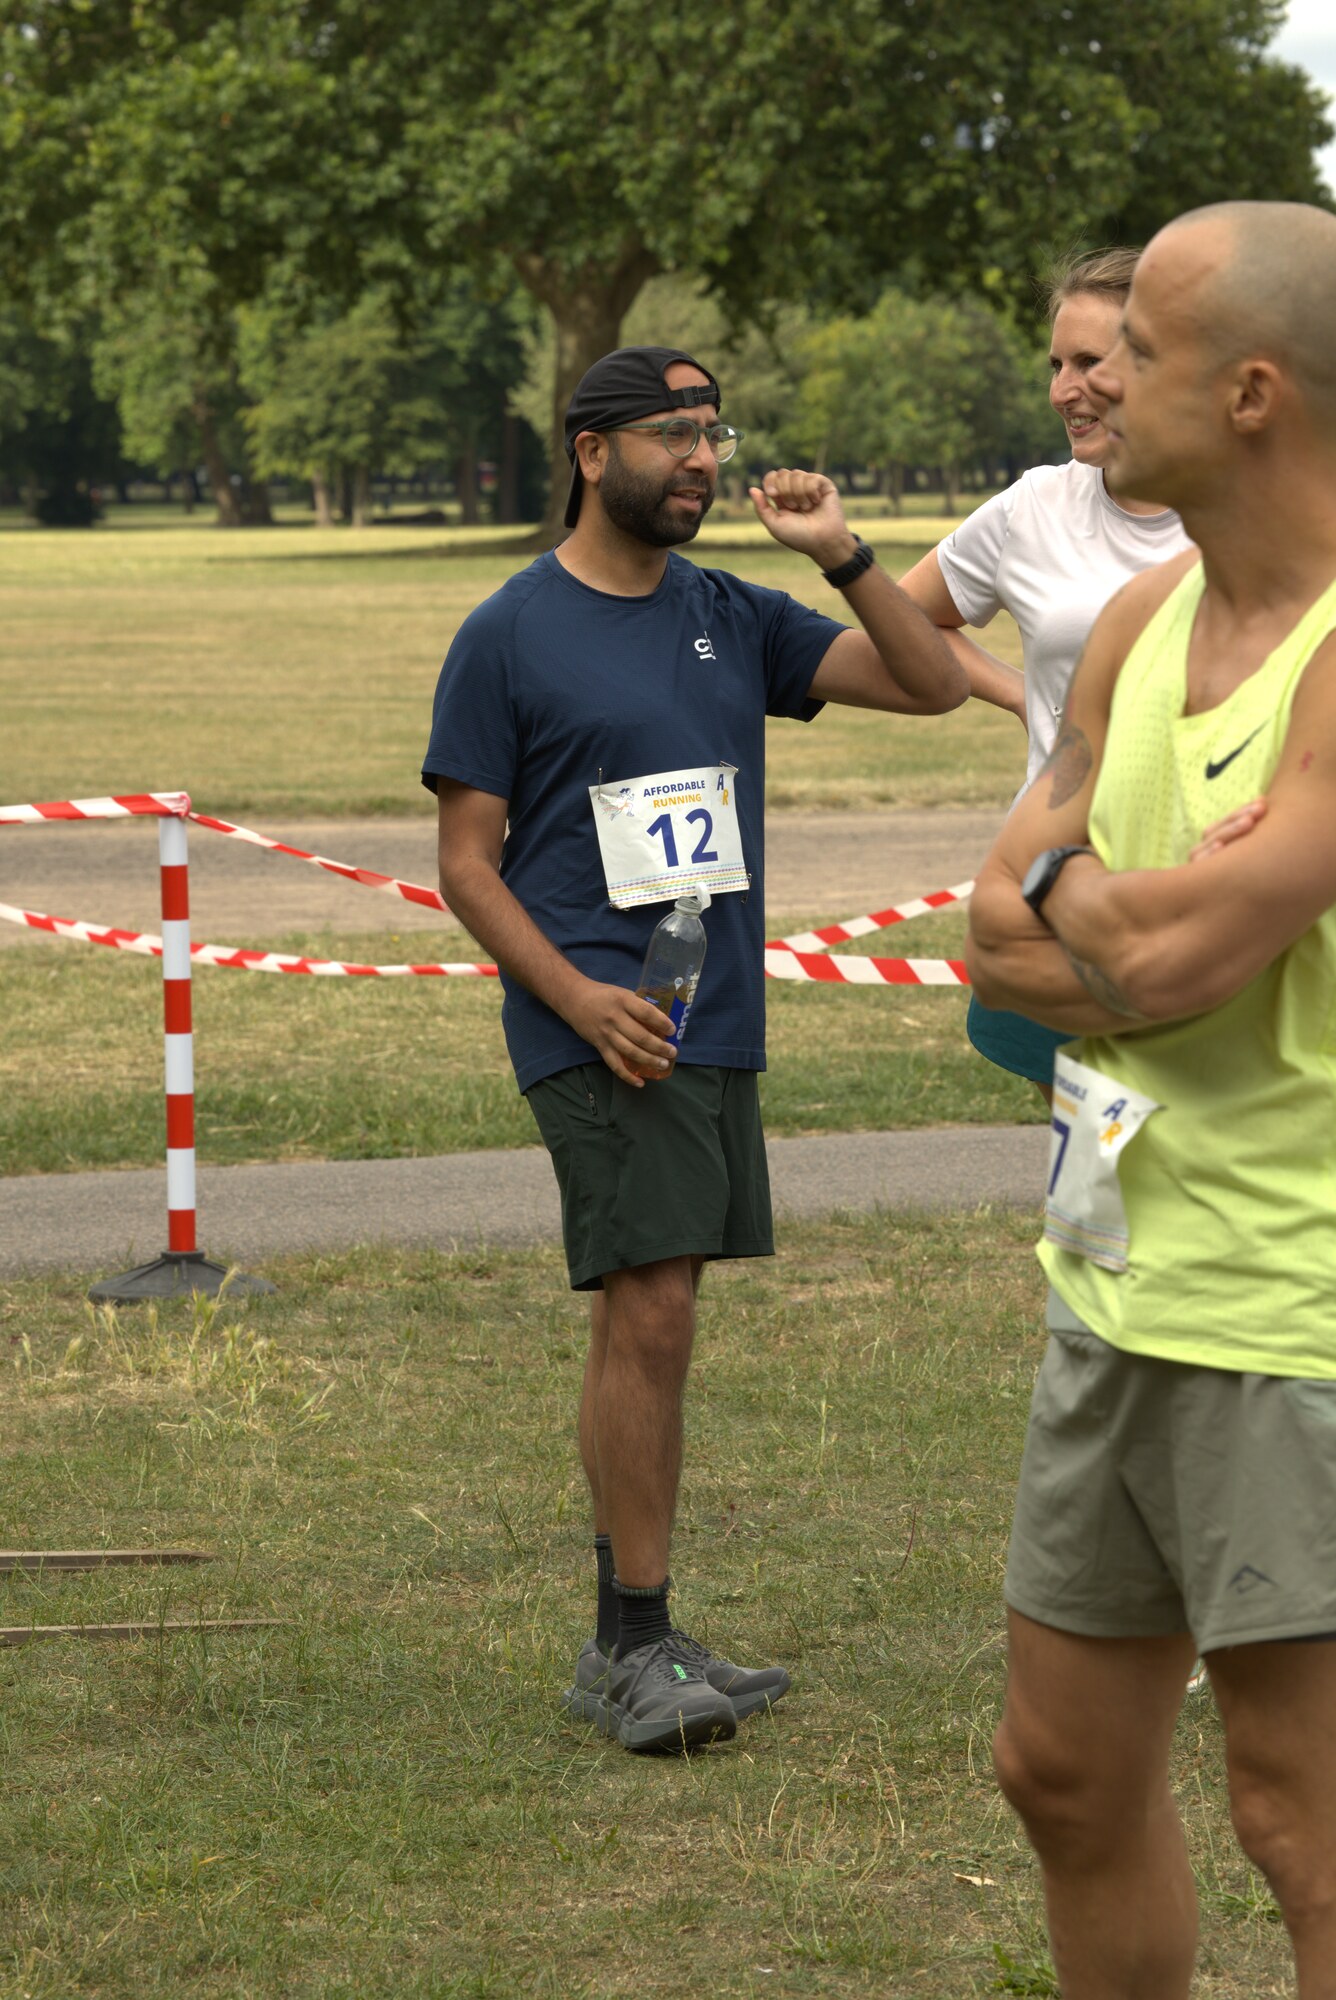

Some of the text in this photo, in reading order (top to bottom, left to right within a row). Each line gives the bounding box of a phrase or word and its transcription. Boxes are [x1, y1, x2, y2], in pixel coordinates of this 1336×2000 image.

[643, 780, 706, 797] AFFORDABLE
[653, 793, 702, 809] RUNNING
[646, 808, 719, 868] 12
[1102, 1098, 1128, 1121] A
